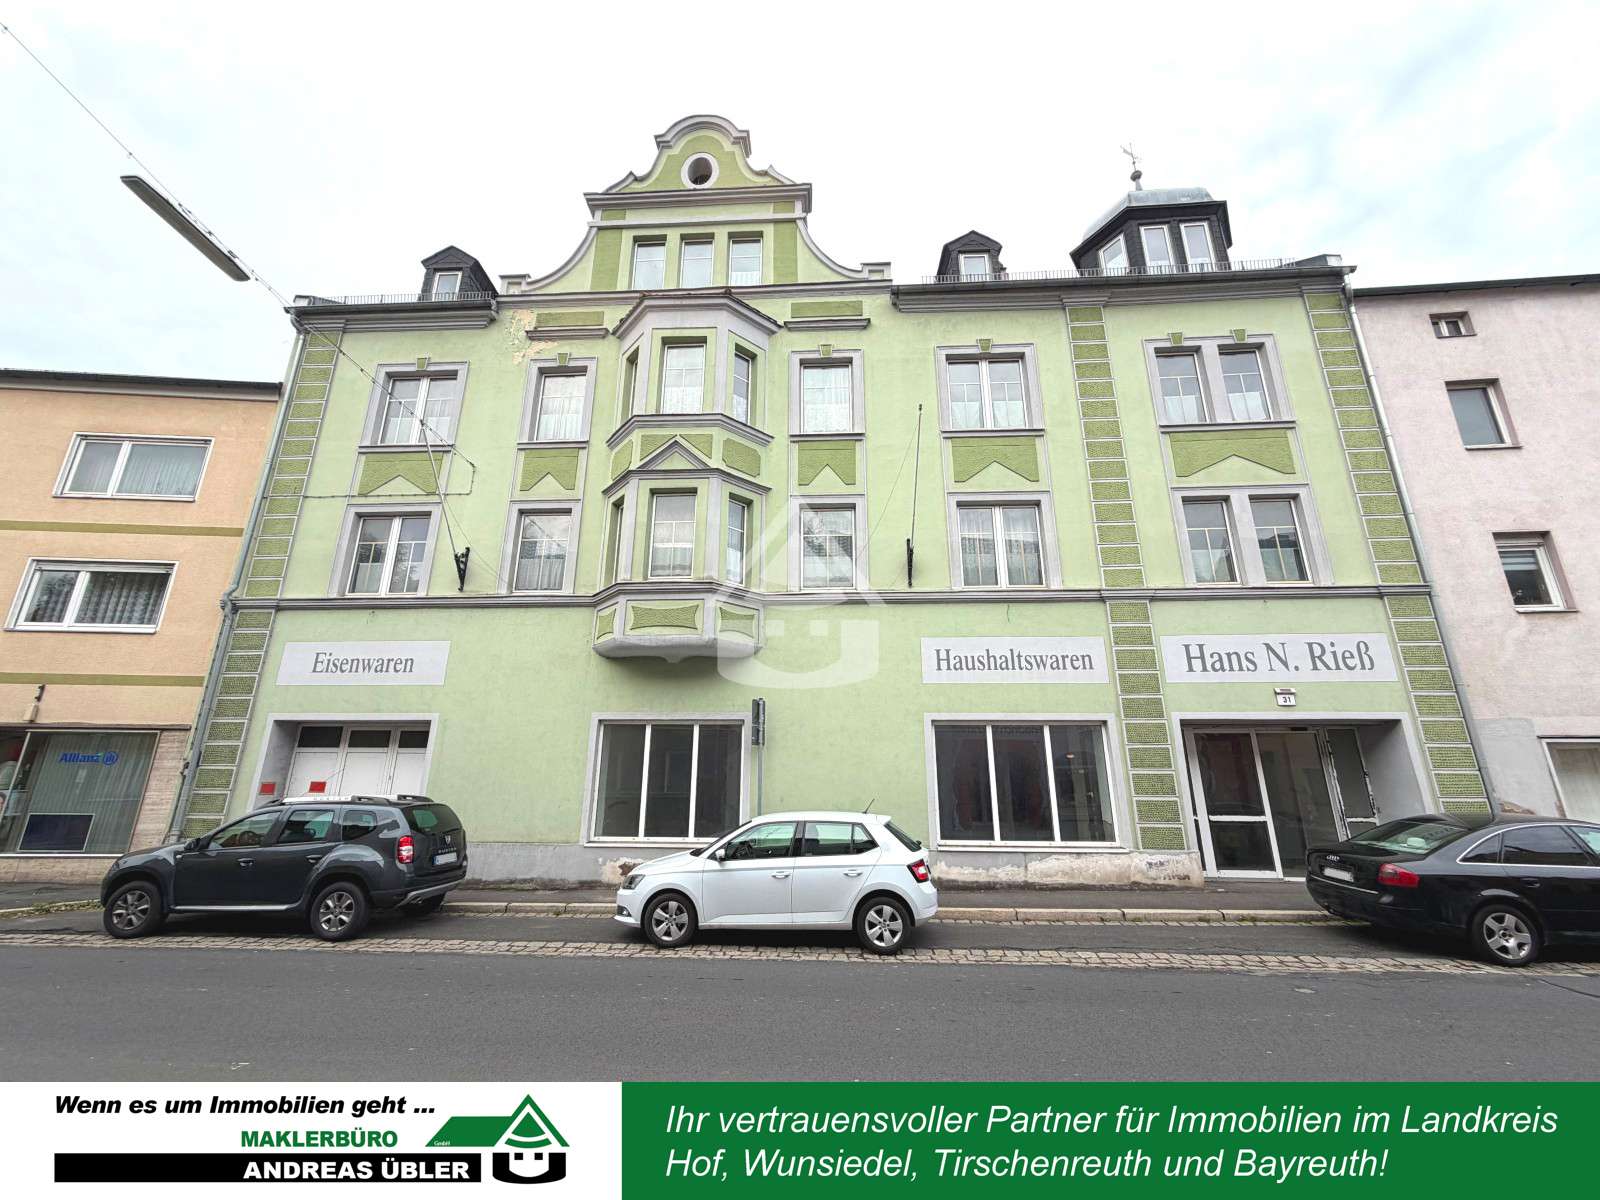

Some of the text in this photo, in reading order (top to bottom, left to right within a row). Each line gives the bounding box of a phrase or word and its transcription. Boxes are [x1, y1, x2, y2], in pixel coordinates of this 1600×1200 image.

[313, 652, 414, 674] Eisenwaren
[935, 648, 1094, 671] Haushaltswaren
[1182, 640, 1376, 673] Hans N. Rieß
[1281, 696, 1292, 704] 31
[59, 753, 101, 763] Allianz
